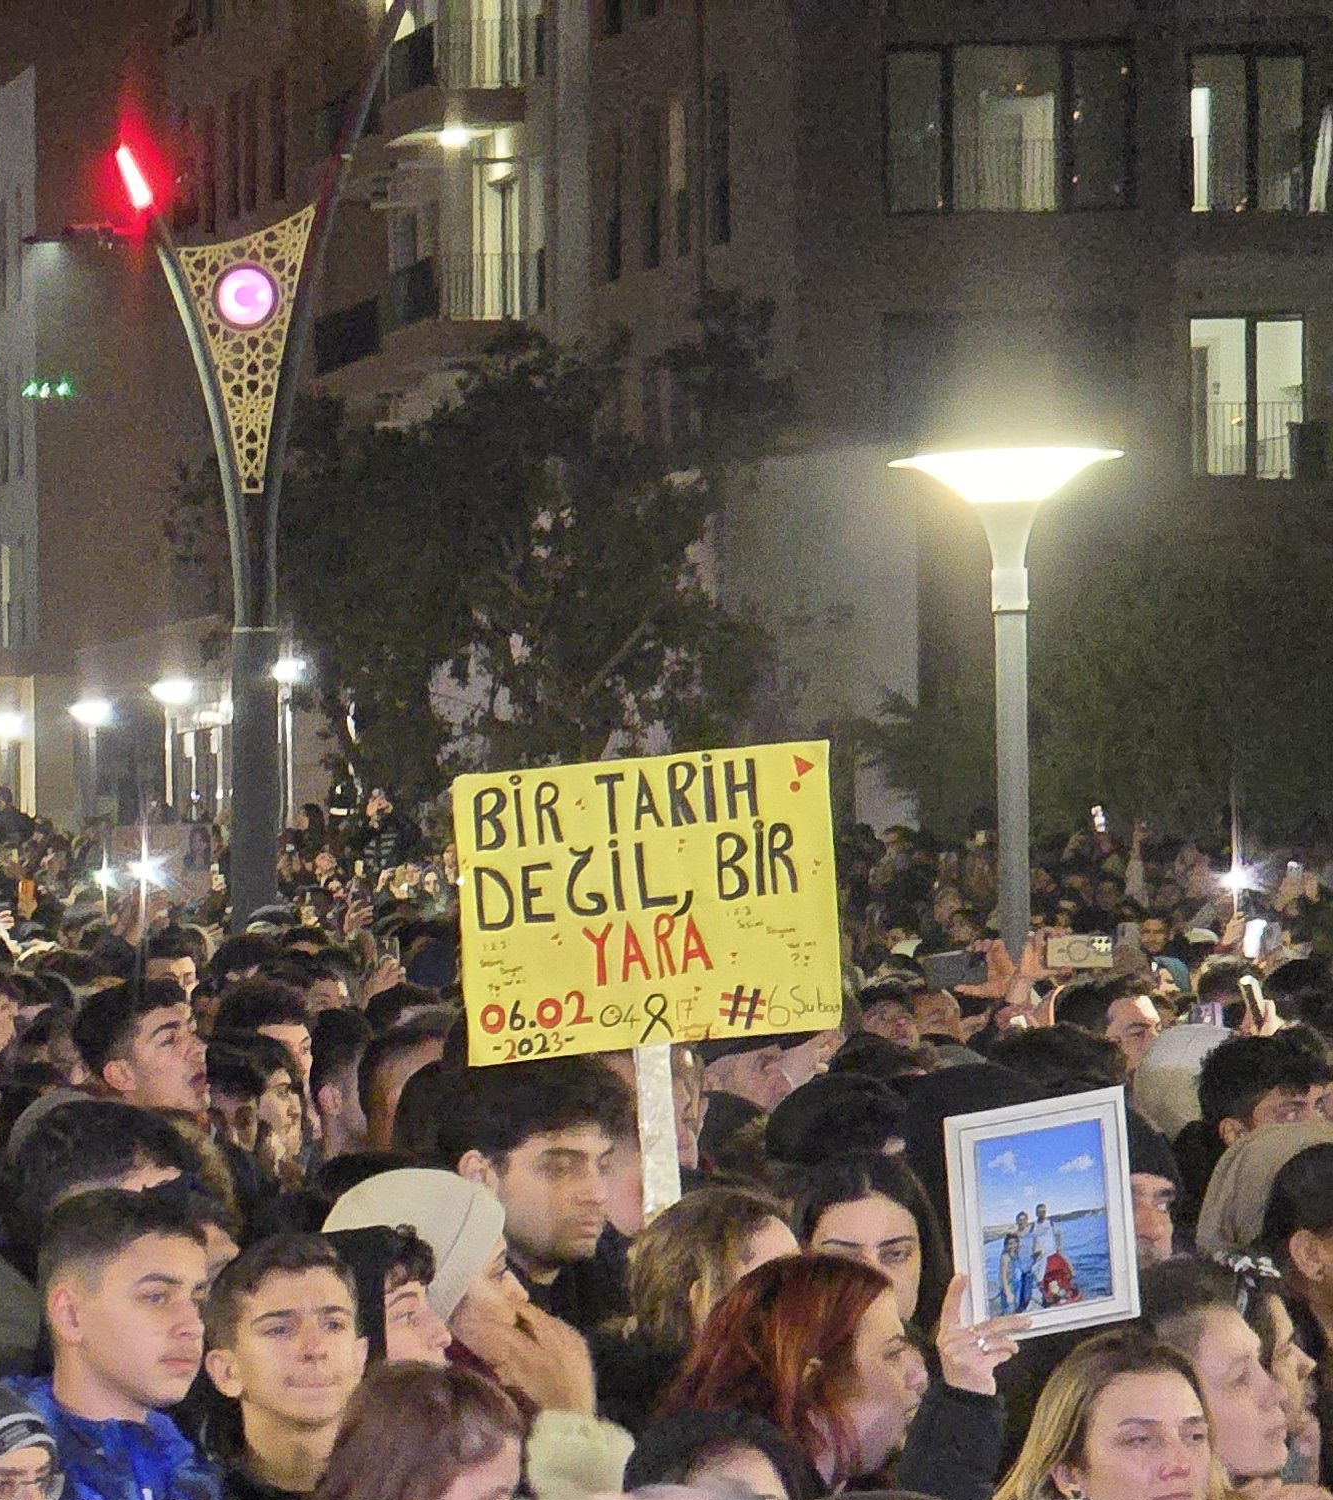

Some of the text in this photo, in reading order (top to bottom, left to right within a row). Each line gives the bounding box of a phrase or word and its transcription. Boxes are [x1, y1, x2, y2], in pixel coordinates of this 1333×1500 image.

[473, 753, 759, 852] BİR TARİH
[716, 819, 799, 901] BİR
[582, 912, 714, 987] YARA
[480, 990, 593, 1034] 06.02
